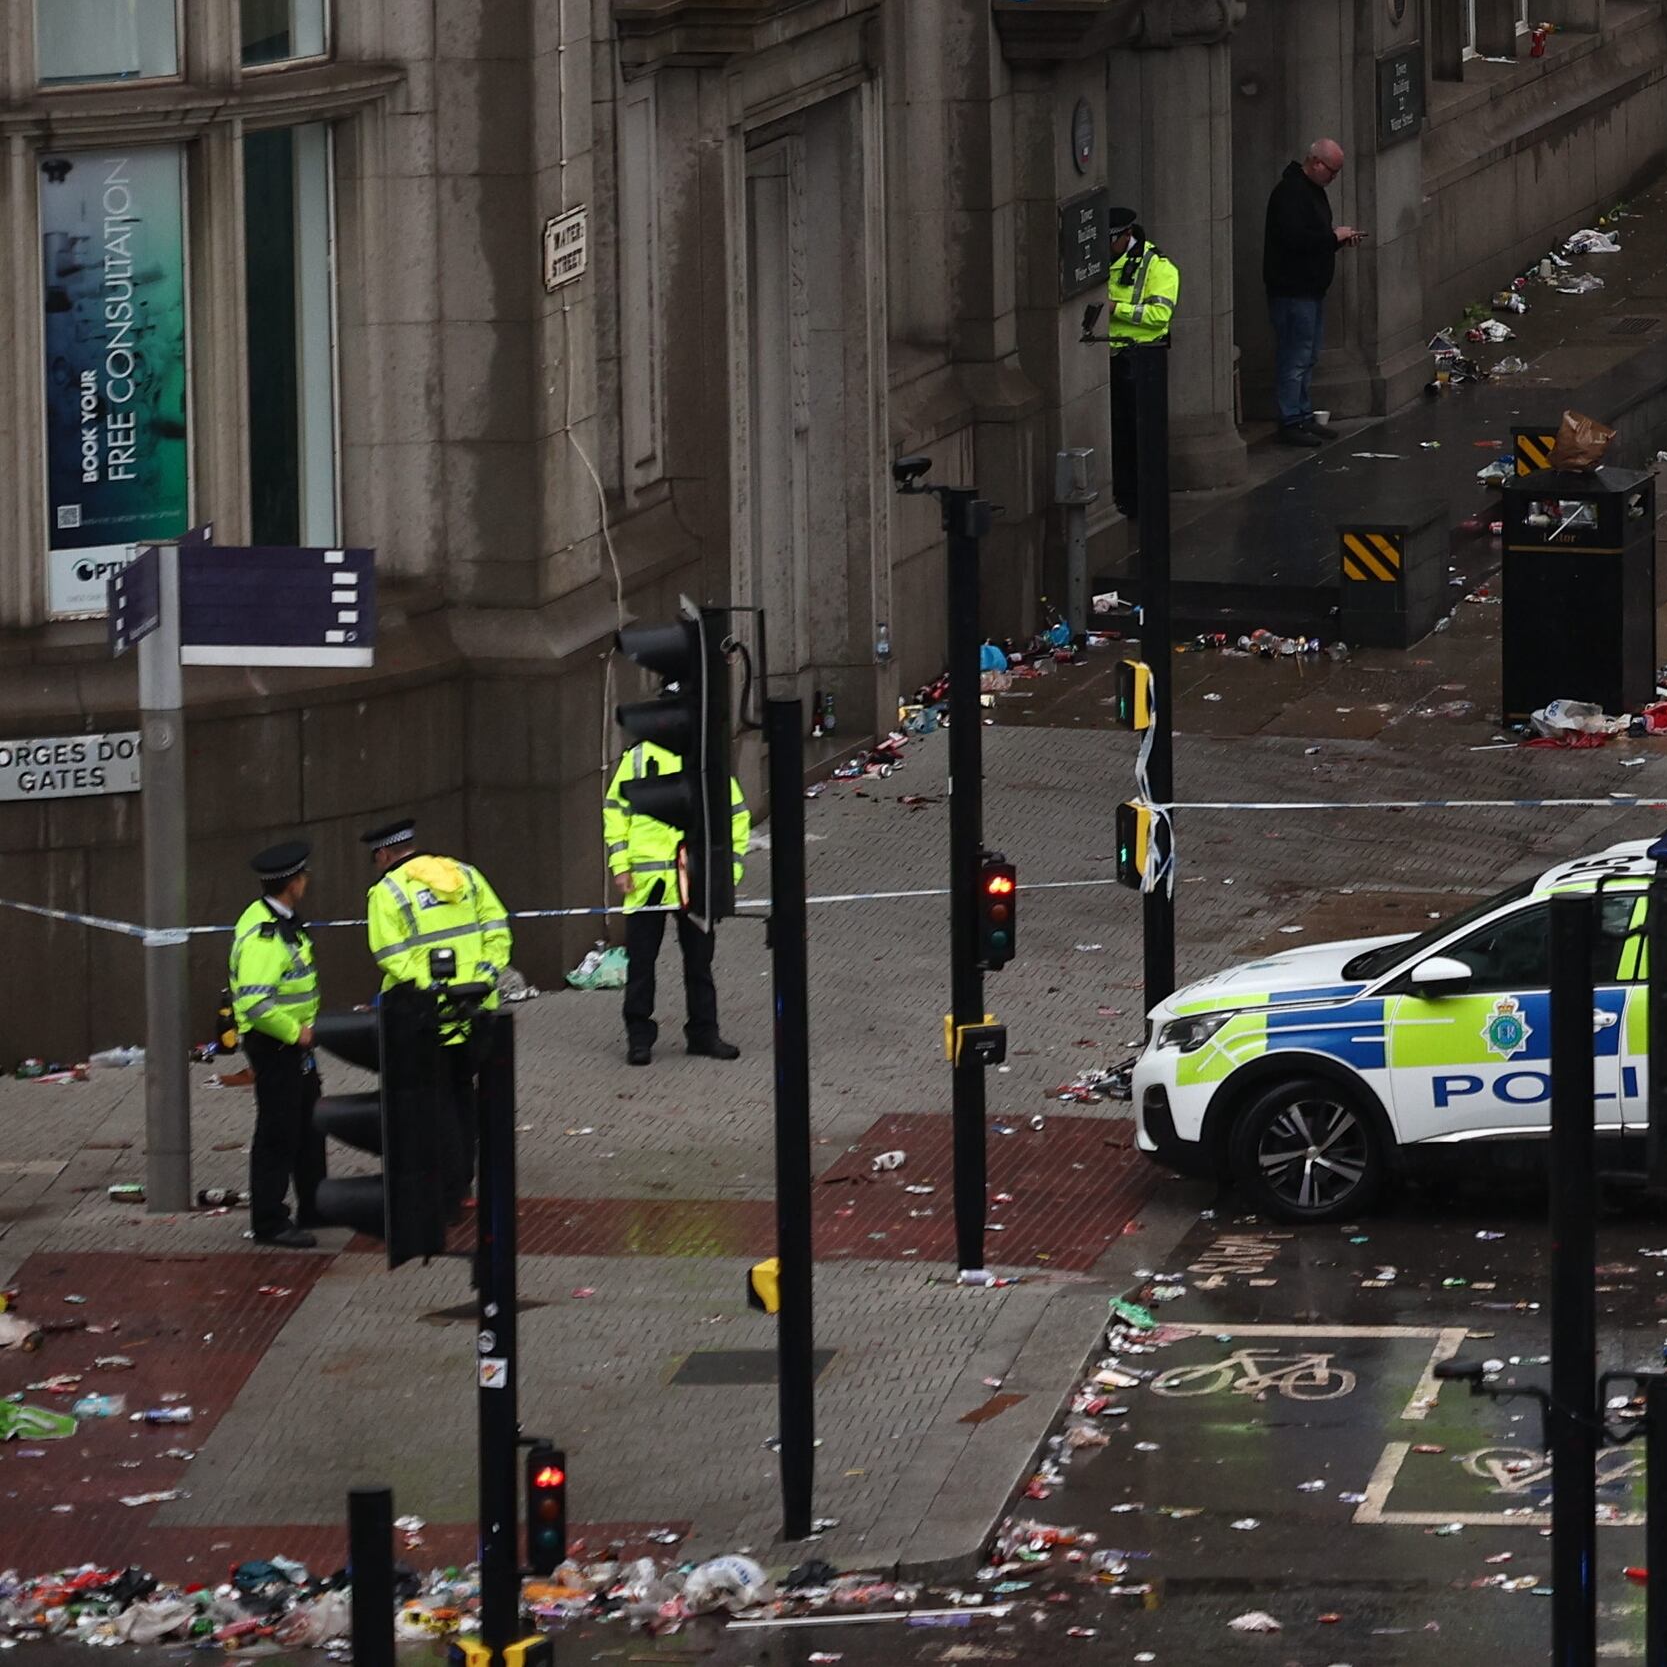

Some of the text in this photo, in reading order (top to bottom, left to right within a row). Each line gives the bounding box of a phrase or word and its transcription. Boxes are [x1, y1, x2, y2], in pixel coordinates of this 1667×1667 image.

[103, 157, 137, 482] FREE CONSULTATION
[80, 369, 98, 483] BOOK YOUR
[17, 766, 106, 791] GATES
